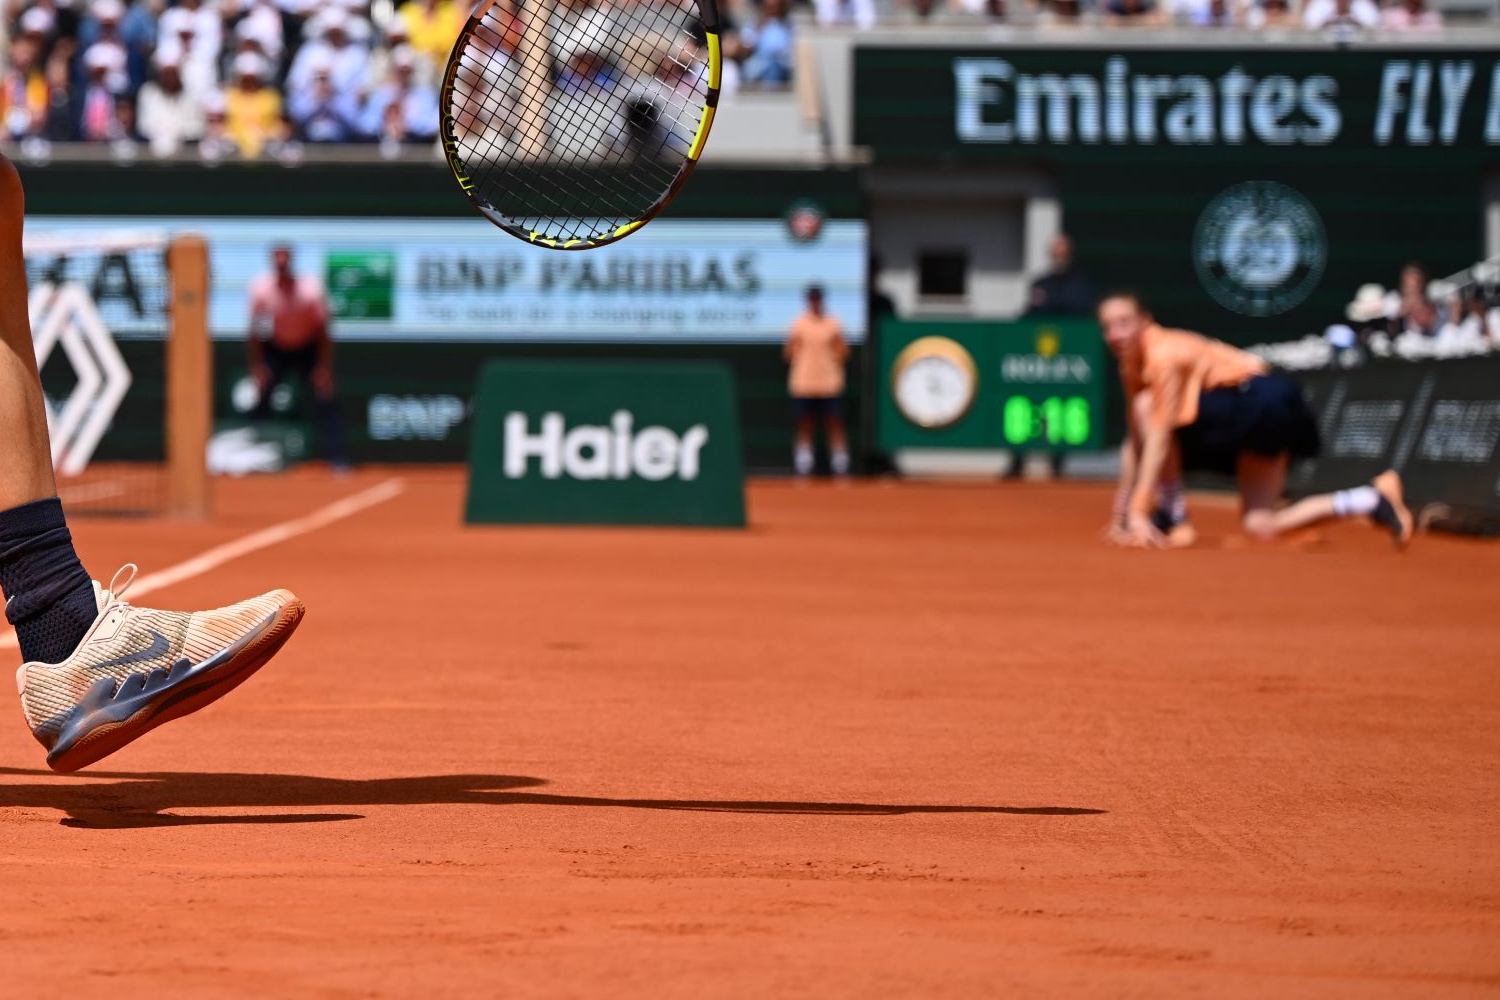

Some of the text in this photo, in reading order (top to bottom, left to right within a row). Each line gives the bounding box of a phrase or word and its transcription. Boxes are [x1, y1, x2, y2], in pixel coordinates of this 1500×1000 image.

[953, 55, 1342, 145] Emirates
[1373, 58, 1476, 146] FLY
[416, 252, 762, 295] BNP PARIBAS
[367, 393, 465, 440] BNP
[503, 409, 709, 481] Haier
